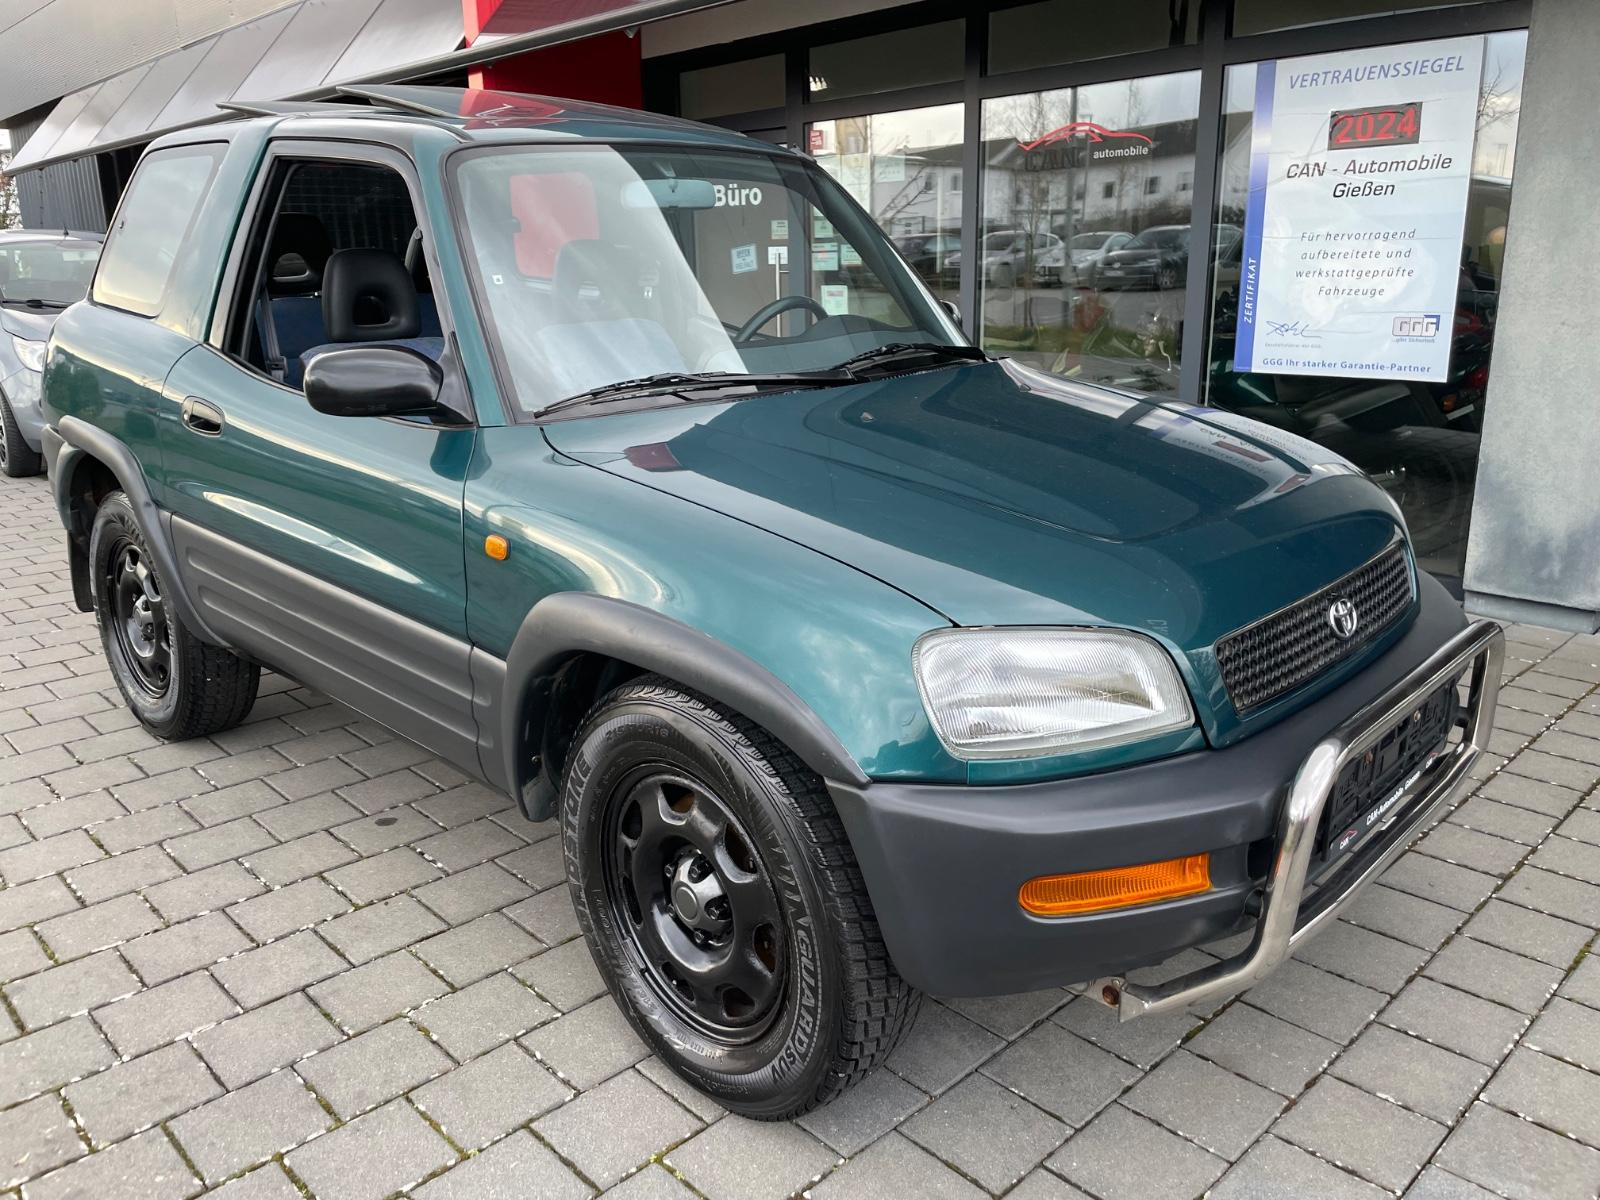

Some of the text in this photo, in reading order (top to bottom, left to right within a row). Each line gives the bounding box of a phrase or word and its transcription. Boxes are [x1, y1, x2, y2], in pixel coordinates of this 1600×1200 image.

[1289, 55, 1465, 90] VERTRAUENSSIEGEL
[1333, 104, 1418, 145] 2024
[1093, 145, 1149, 160] automobile
[1286, 161, 1327, 179] CAN
[1343, 154, 1453, 176] Automobile
[713, 183, 762, 207] Büro
[1332, 181, 1396, 199] Gießen
[1300, 228, 1417, 242] Für hervorragend
[1300, 247, 1413, 261] aufbereitete und
[1295, 266, 1415, 280] werkstattgeprüfte
[1243, 257, 1257, 325] ZERTIFIKAT
[1318, 286, 1385, 299] Fahrzeuge
[1262, 357, 1432, 374] GGG Ihr starker Garantie-Partner
[770, 1048, 798, 1084] SUV
